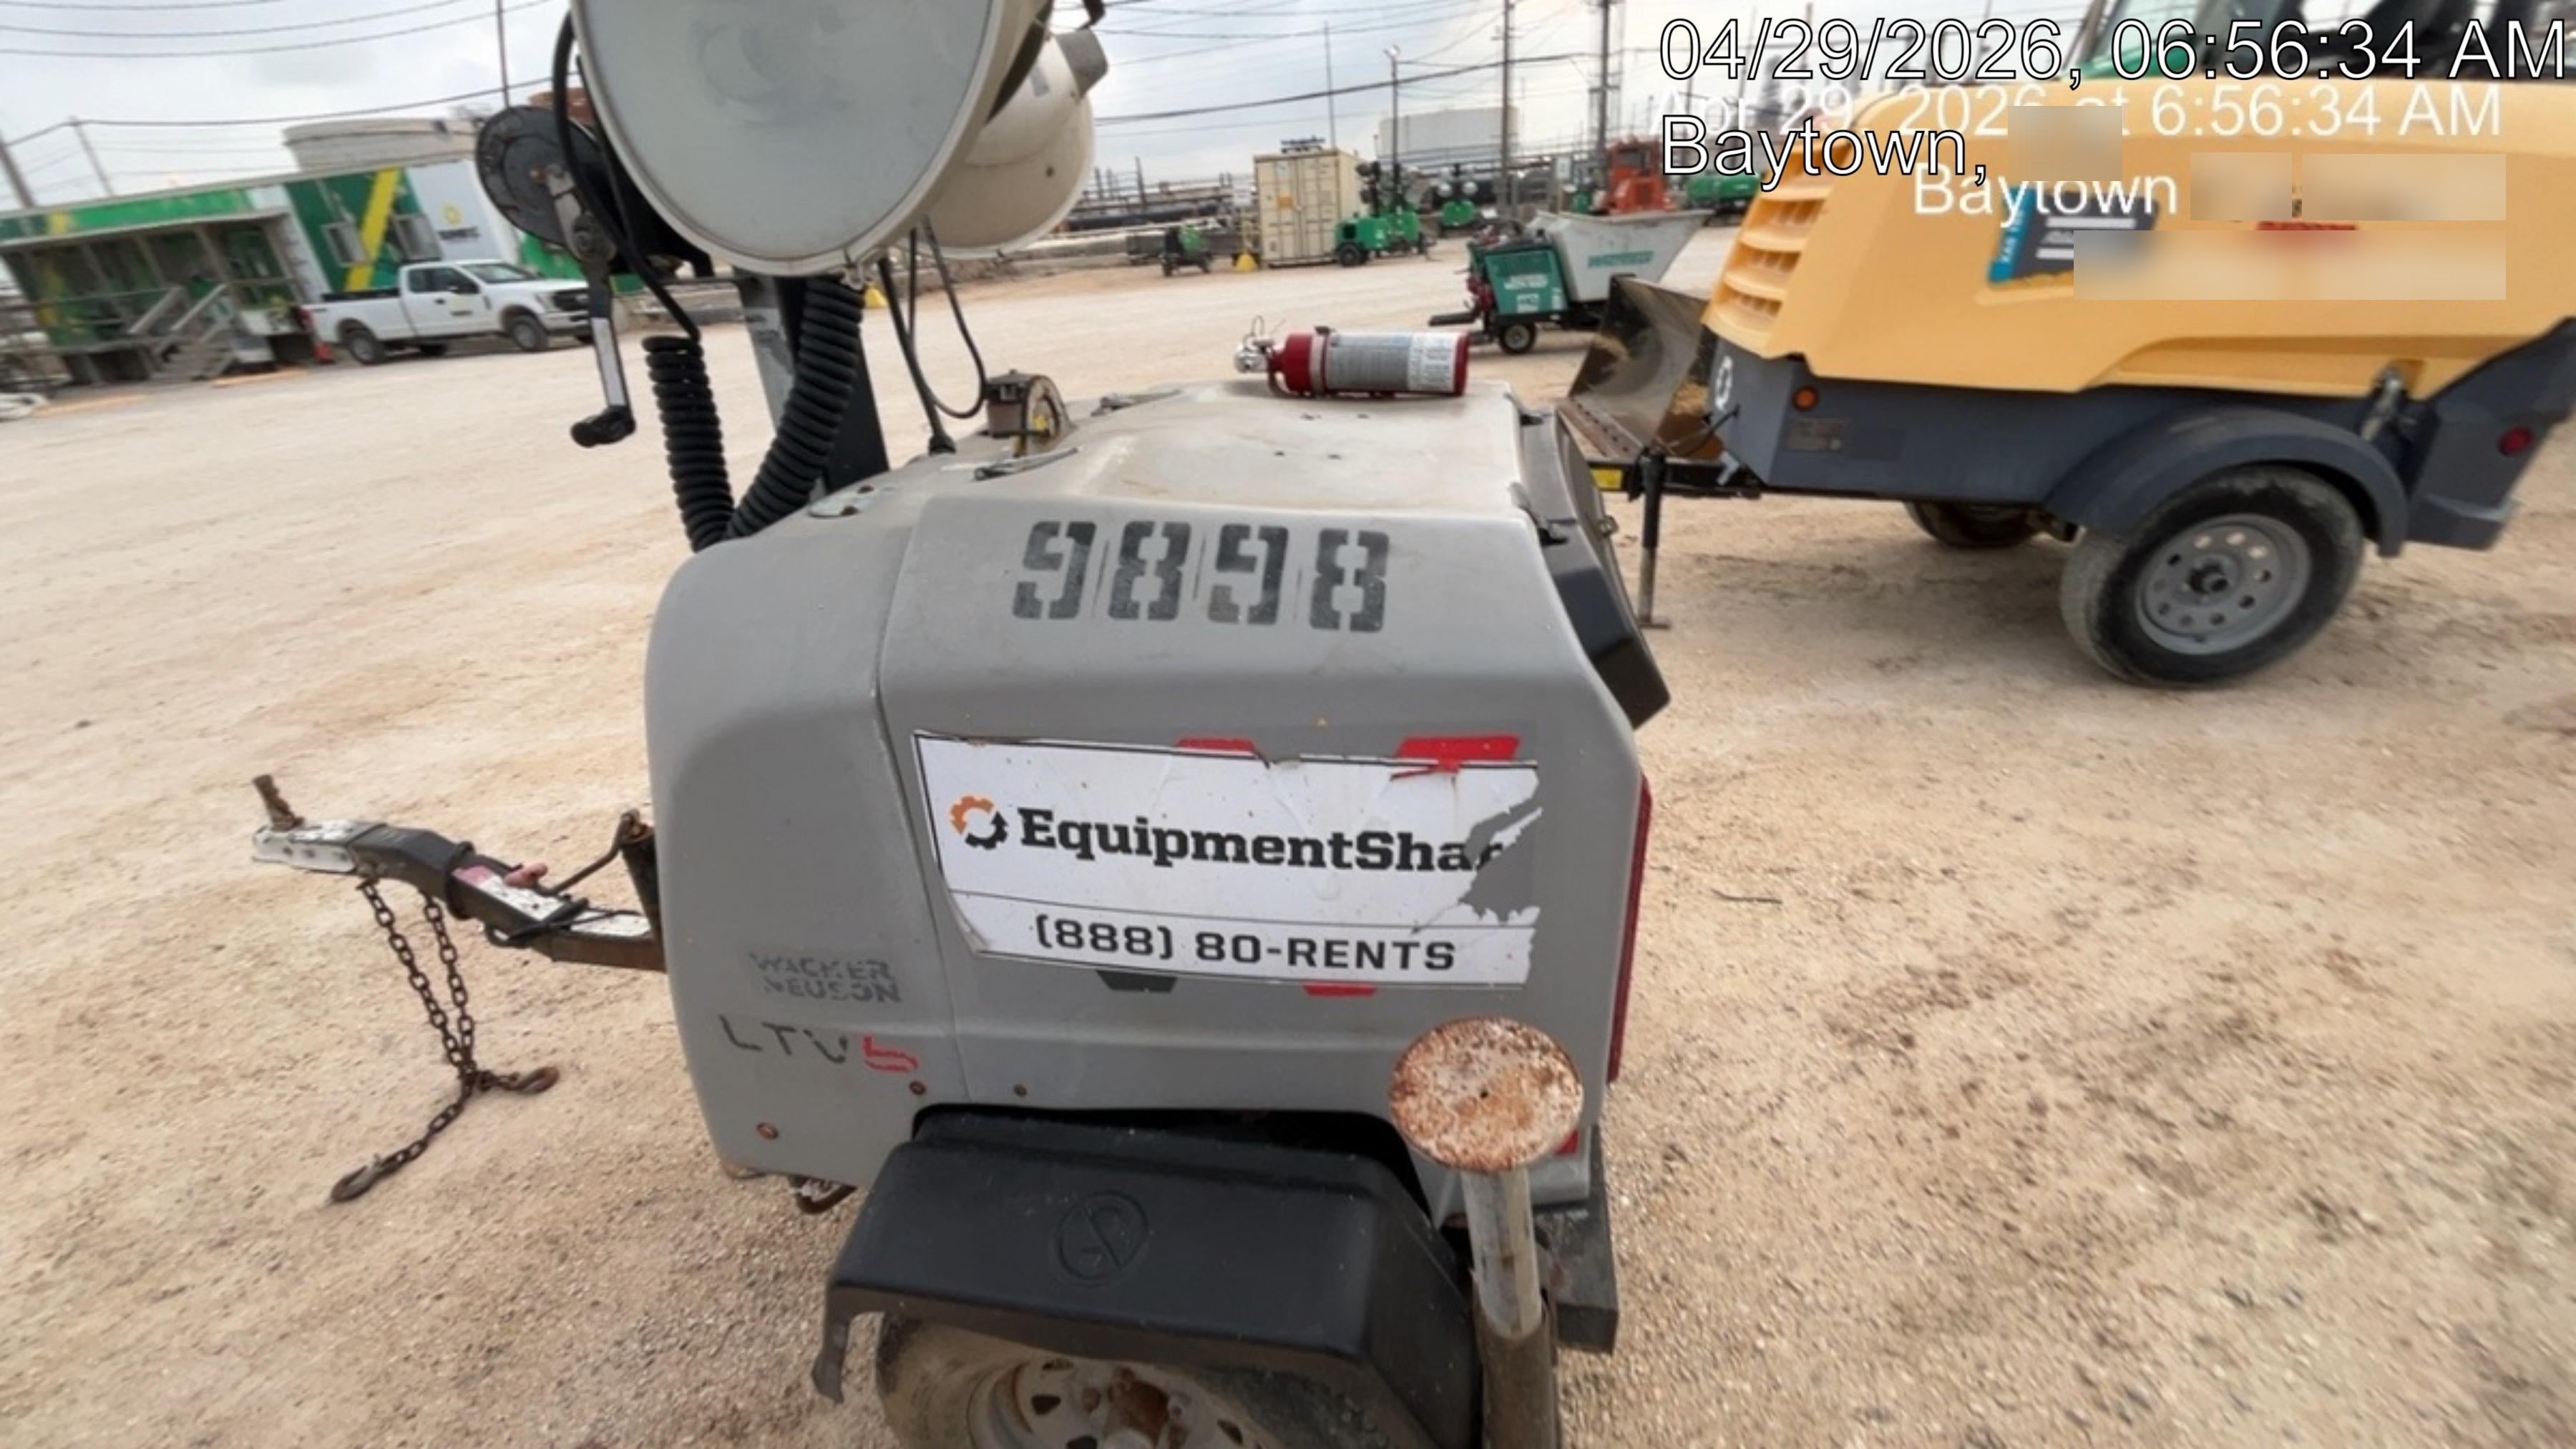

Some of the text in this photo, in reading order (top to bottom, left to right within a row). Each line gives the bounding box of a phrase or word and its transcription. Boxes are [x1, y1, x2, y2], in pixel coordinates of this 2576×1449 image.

[1012, 521, 1390, 633] 9898
[1035, 914, 1457, 971] (888) 80-RENTS
